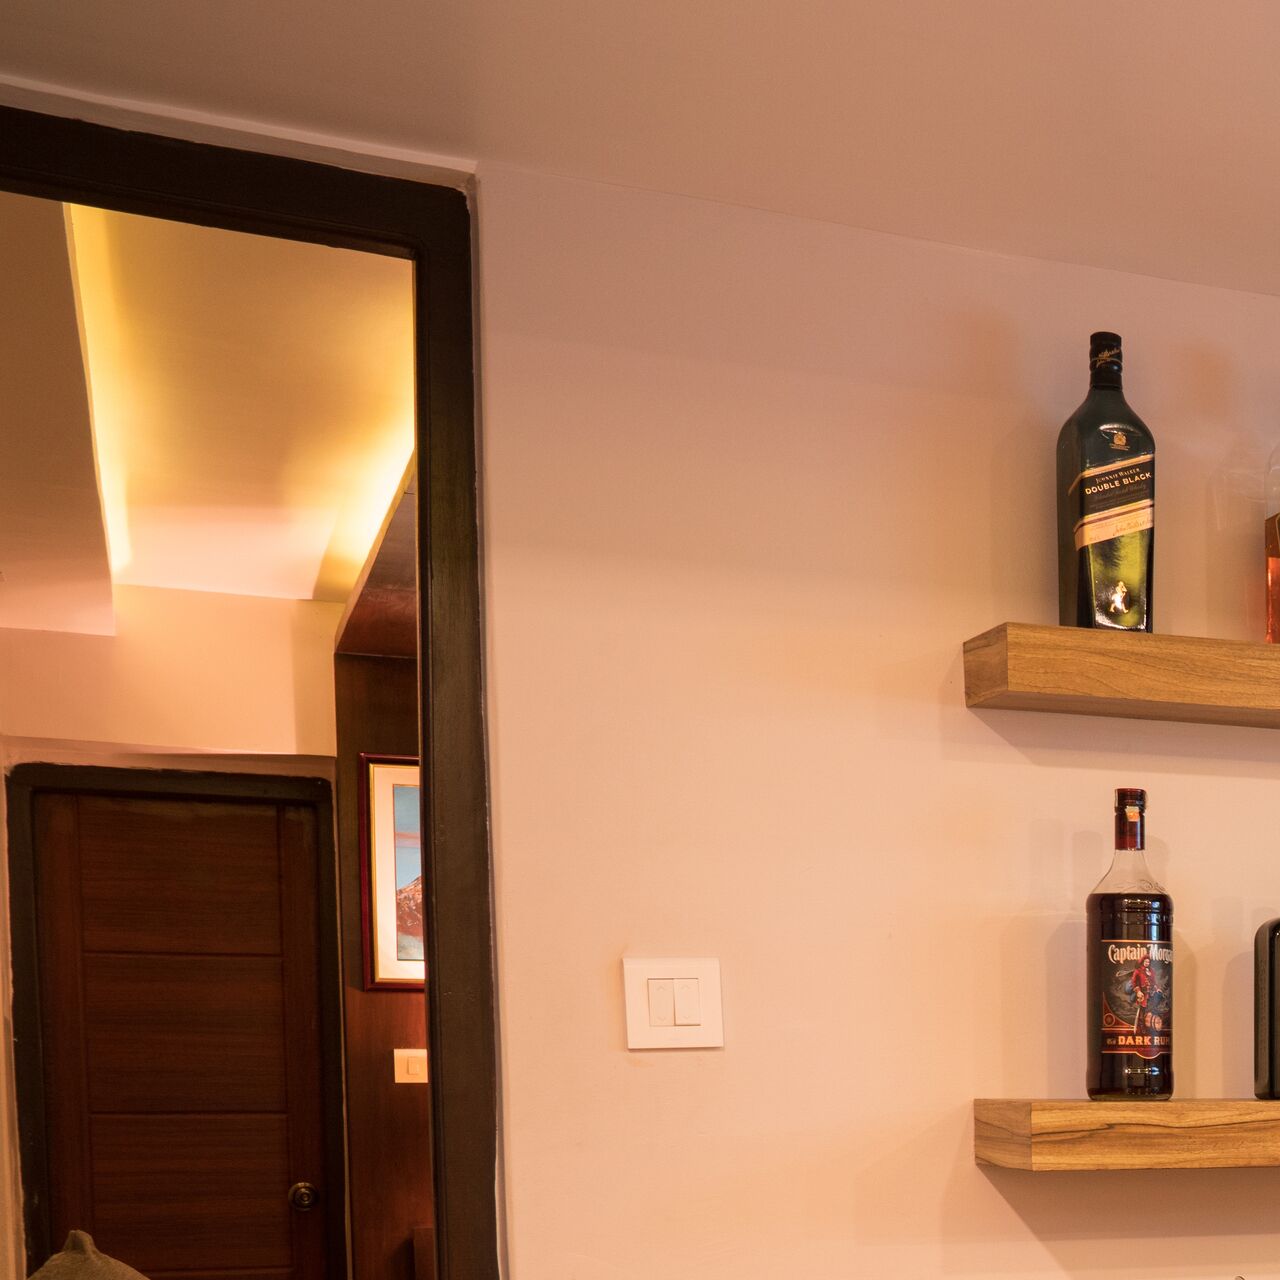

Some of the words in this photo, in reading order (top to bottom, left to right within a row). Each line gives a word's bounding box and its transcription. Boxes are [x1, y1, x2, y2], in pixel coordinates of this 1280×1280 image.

[1085, 480, 1120, 495] DOUBLE
[1122, 472, 1152, 485] BLACK
[1108, 944, 1148, 964] Captain
[1118, 1036, 1152, 1046] DARK
